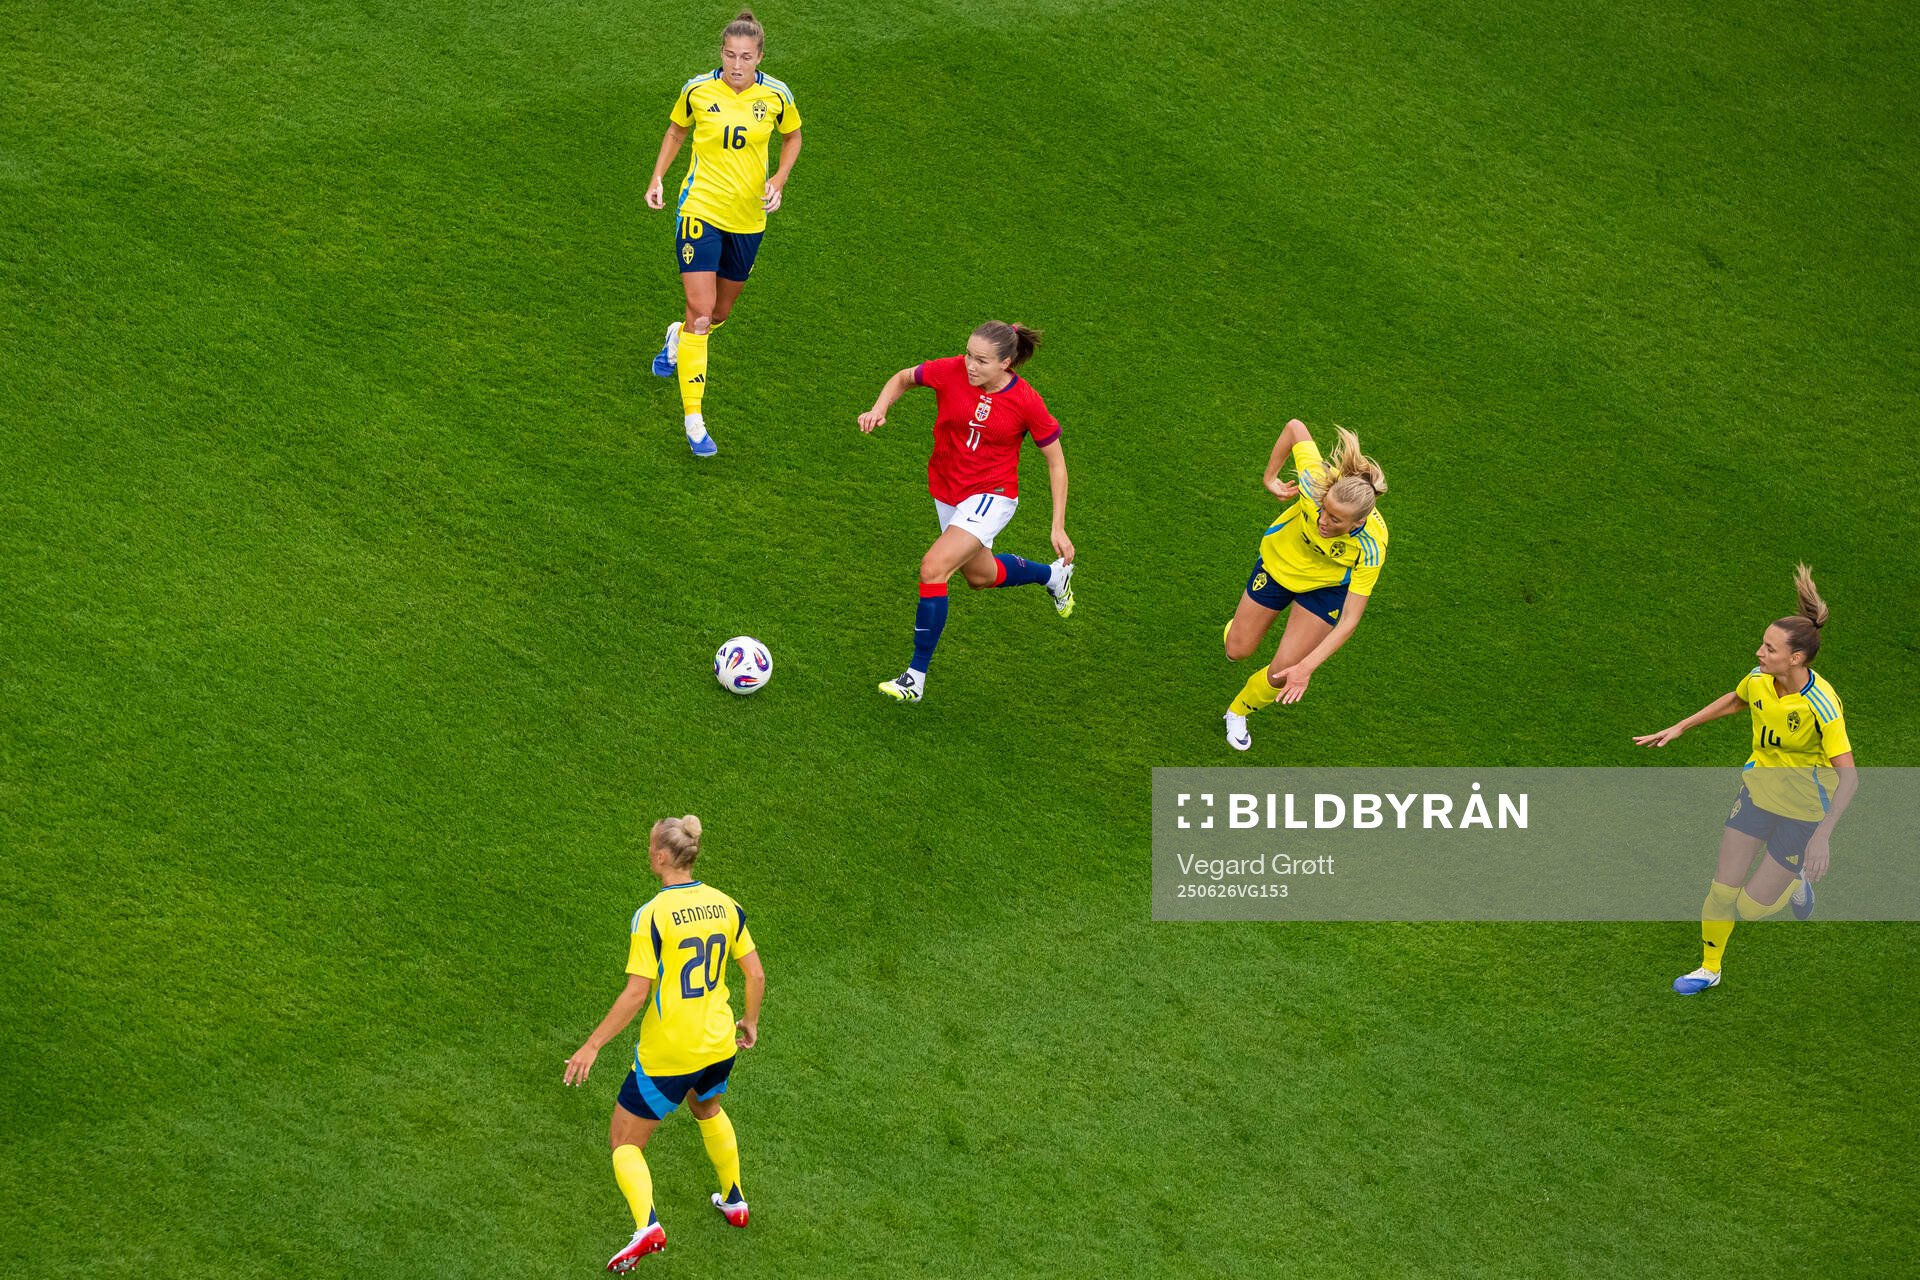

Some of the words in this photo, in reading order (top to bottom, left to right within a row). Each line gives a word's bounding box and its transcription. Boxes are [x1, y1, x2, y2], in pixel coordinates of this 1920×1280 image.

[722, 124, 748, 150] 16
[681, 215, 704, 240] 16
[965, 427, 981, 452] 11
[975, 493, 995, 518] 11
[1760, 725, 1782, 749] 14
[671, 904, 727, 926] BENNISON
[677, 932, 727, 1000] 20
